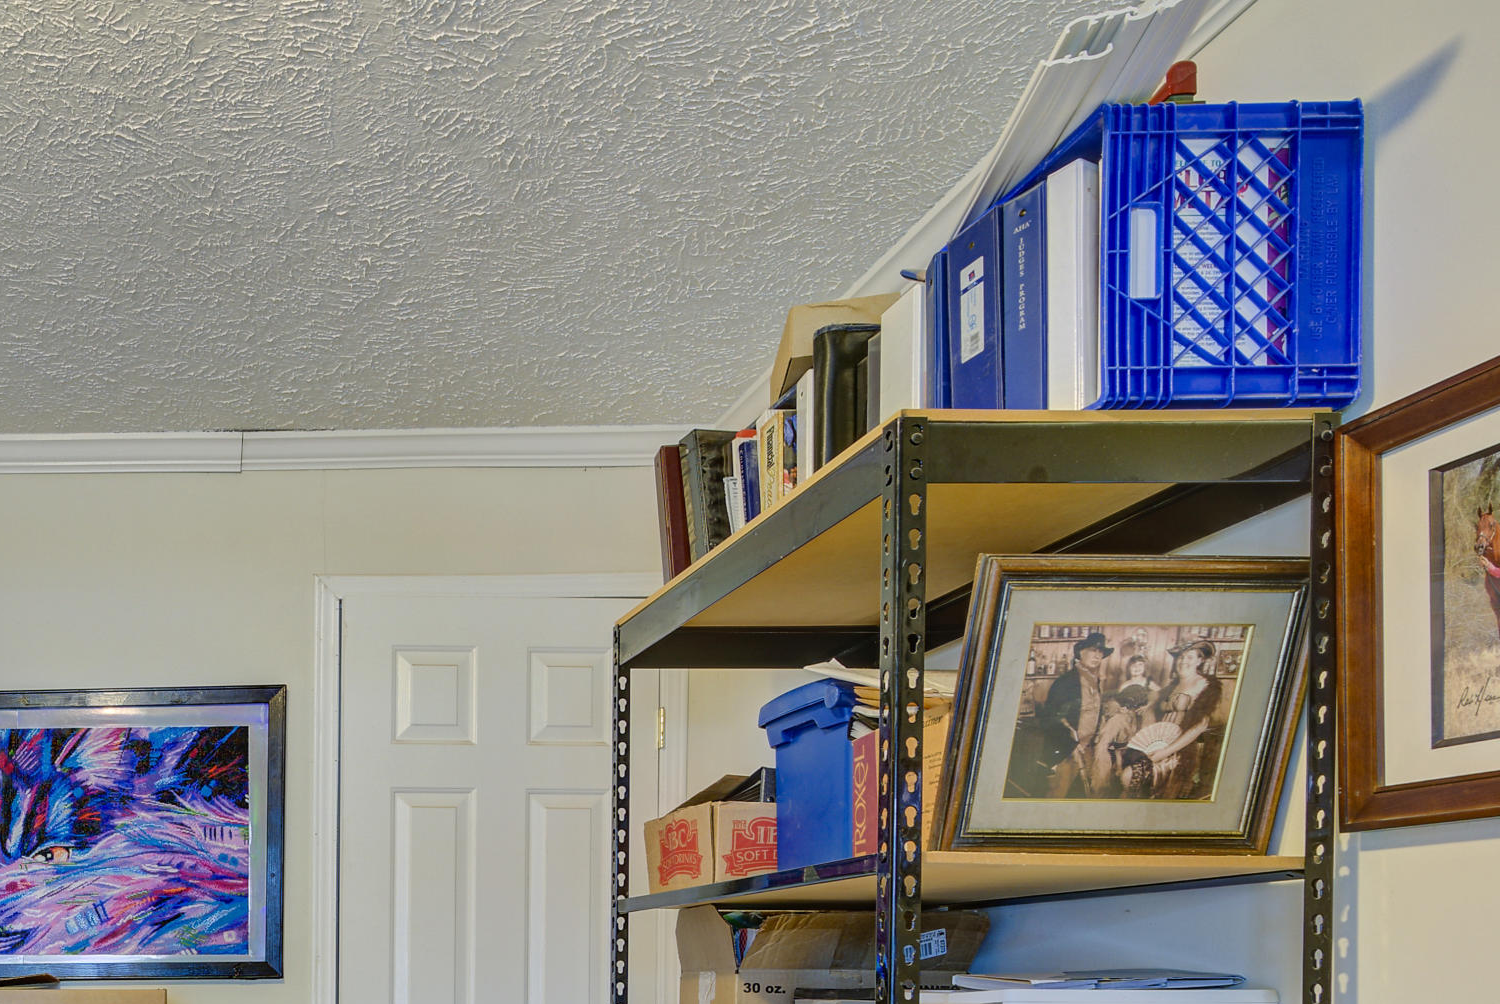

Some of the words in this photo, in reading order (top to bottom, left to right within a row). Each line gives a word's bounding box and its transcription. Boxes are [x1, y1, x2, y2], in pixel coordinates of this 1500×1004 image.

[1311, 157, 1325, 223] REGISTERED
[1326, 199, 1339, 214] BY
[1012, 221, 1031, 234] AHA
[1311, 229, 1324, 257] THAN
[1325, 219, 1339, 285] PUNISHABLE
[1310, 262, 1323, 295] OTHER
[1018, 283, 1026, 331] PROGRAM
[1310, 302, 1323, 315] BY
[1325, 290, 1338, 324] OWNER
[1310, 319, 1323, 340] USE
[766, 424, 775, 469] Financial
[854, 743, 869, 858] TROXEL
[674, 853, 697, 865] DRINKS
[736, 849, 770, 863] SOFT
[743, 982, 761, 994] 30
[765, 985, 786, 994] oz.
